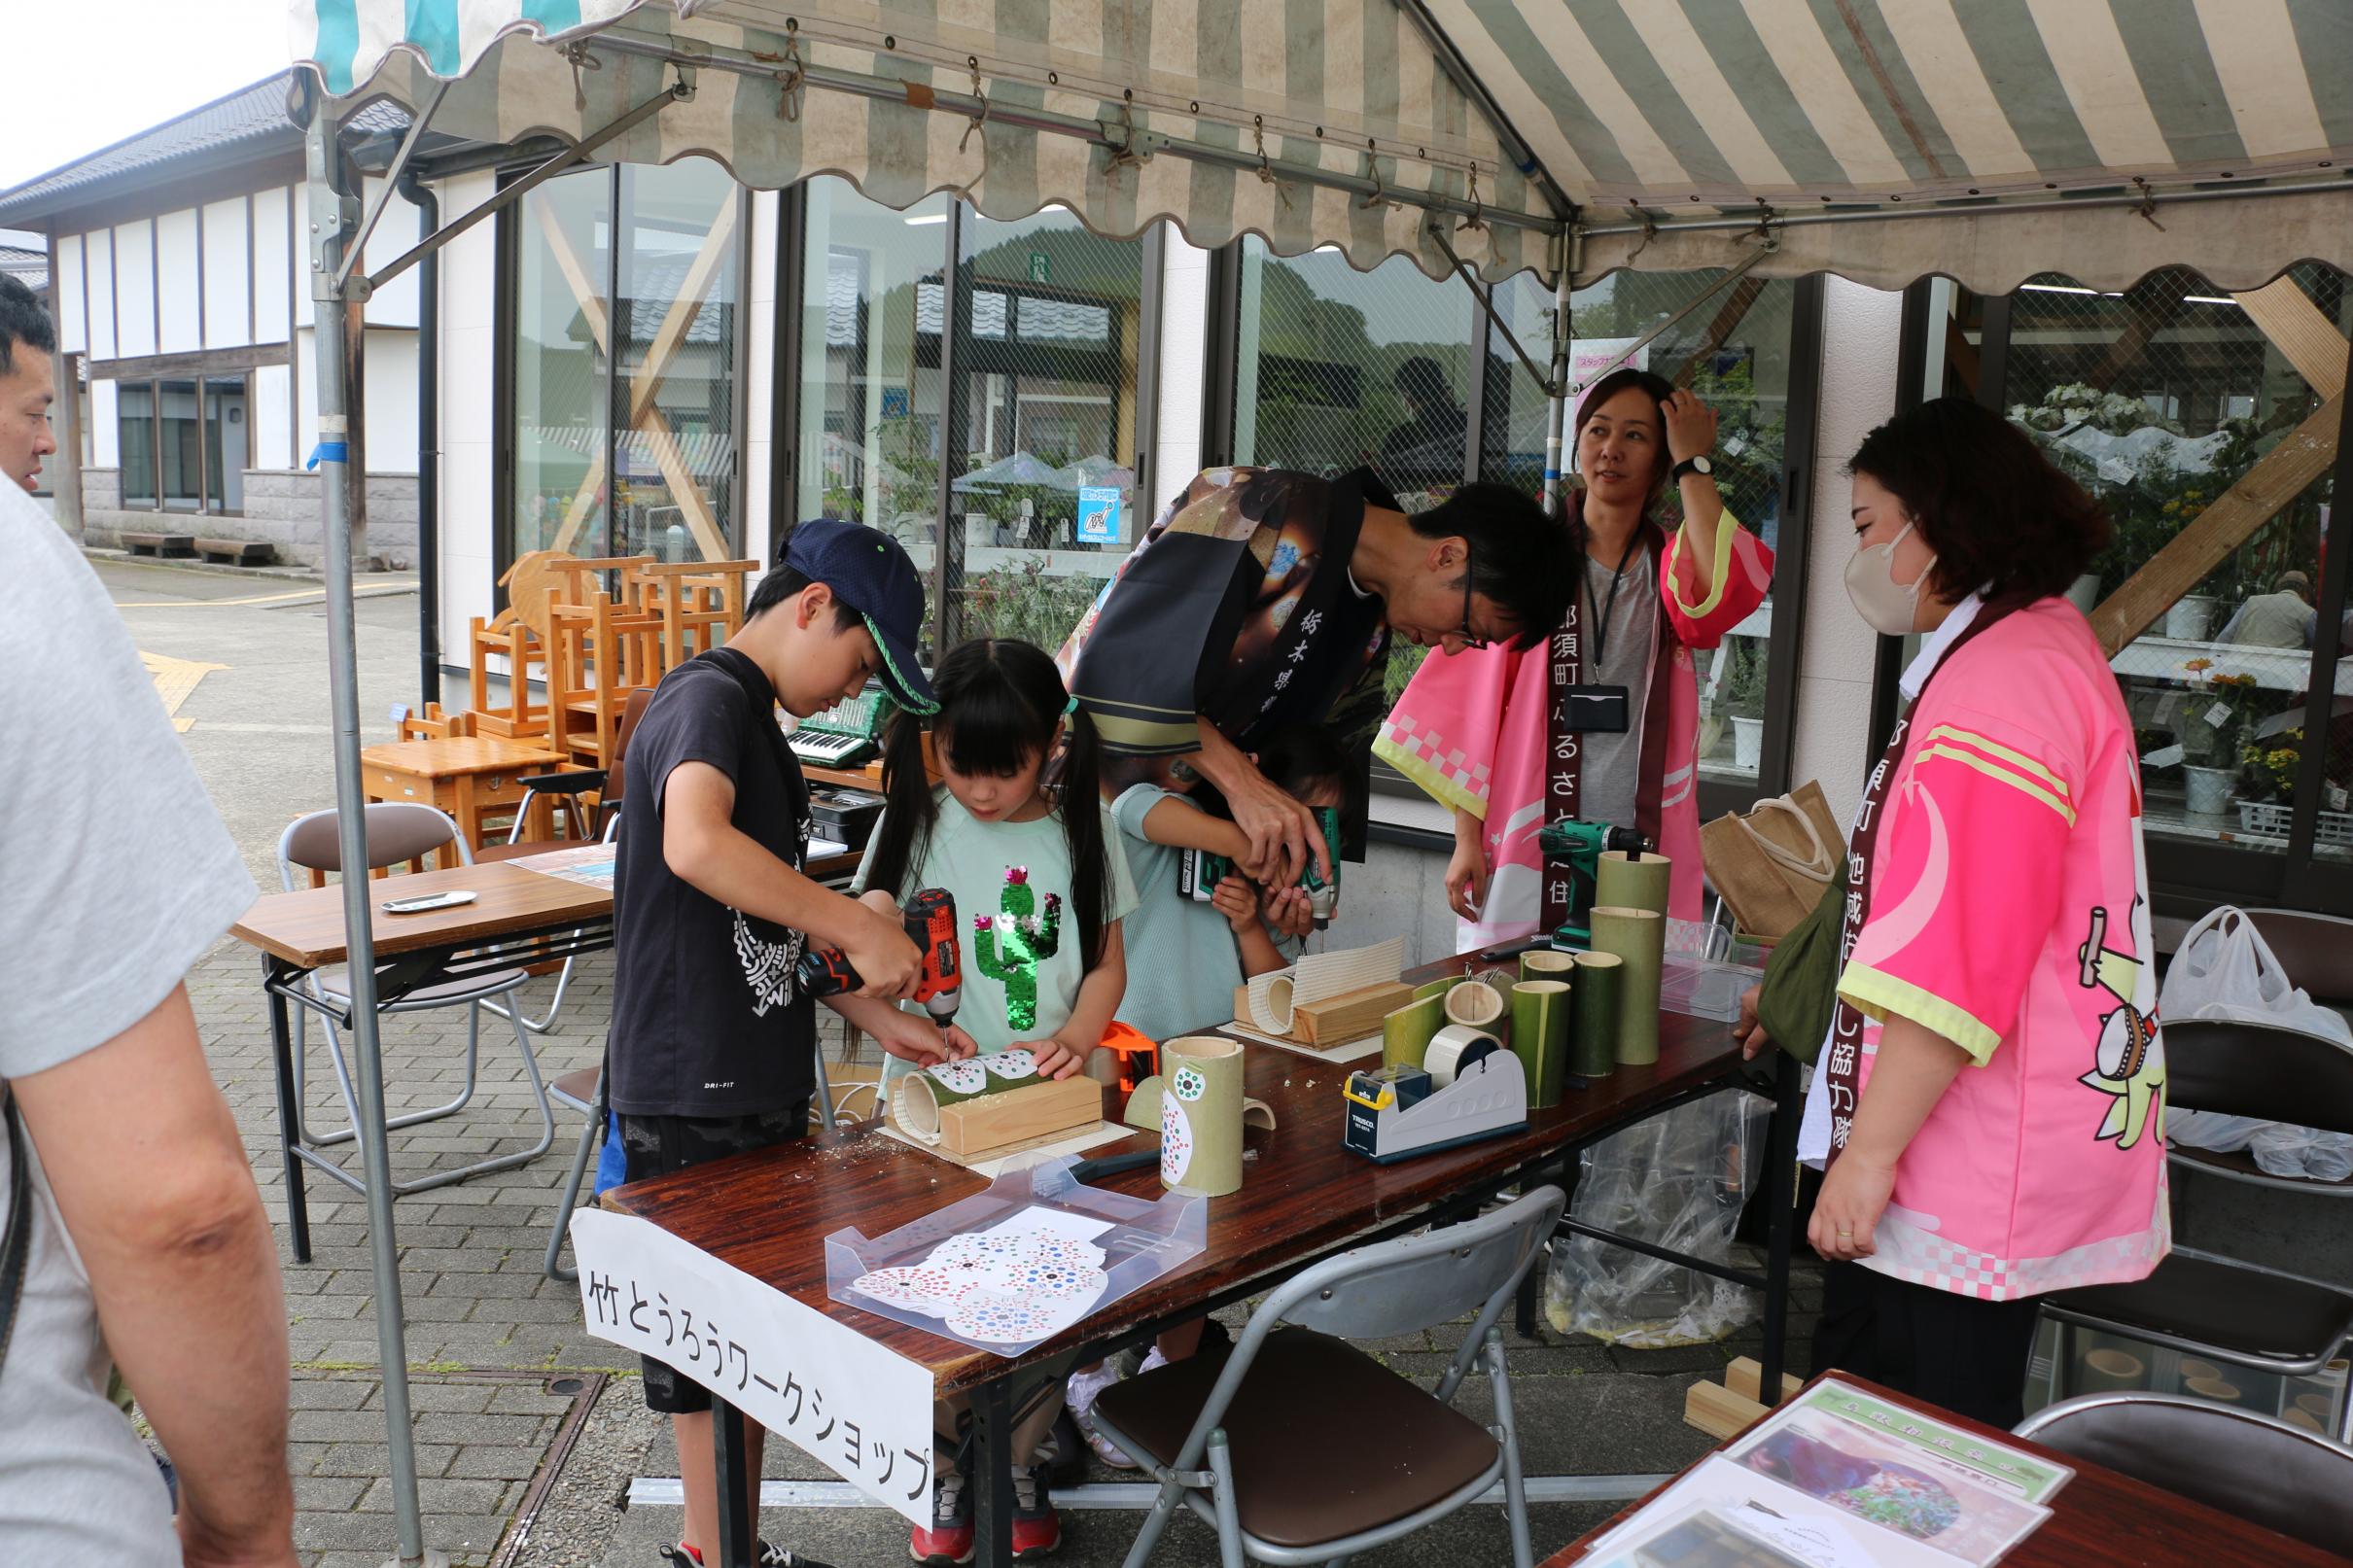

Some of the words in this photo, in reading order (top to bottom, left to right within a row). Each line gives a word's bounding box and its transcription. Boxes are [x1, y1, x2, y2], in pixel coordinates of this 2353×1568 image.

[588, 1270, 931, 1501] 竹とうろうワークショップ
